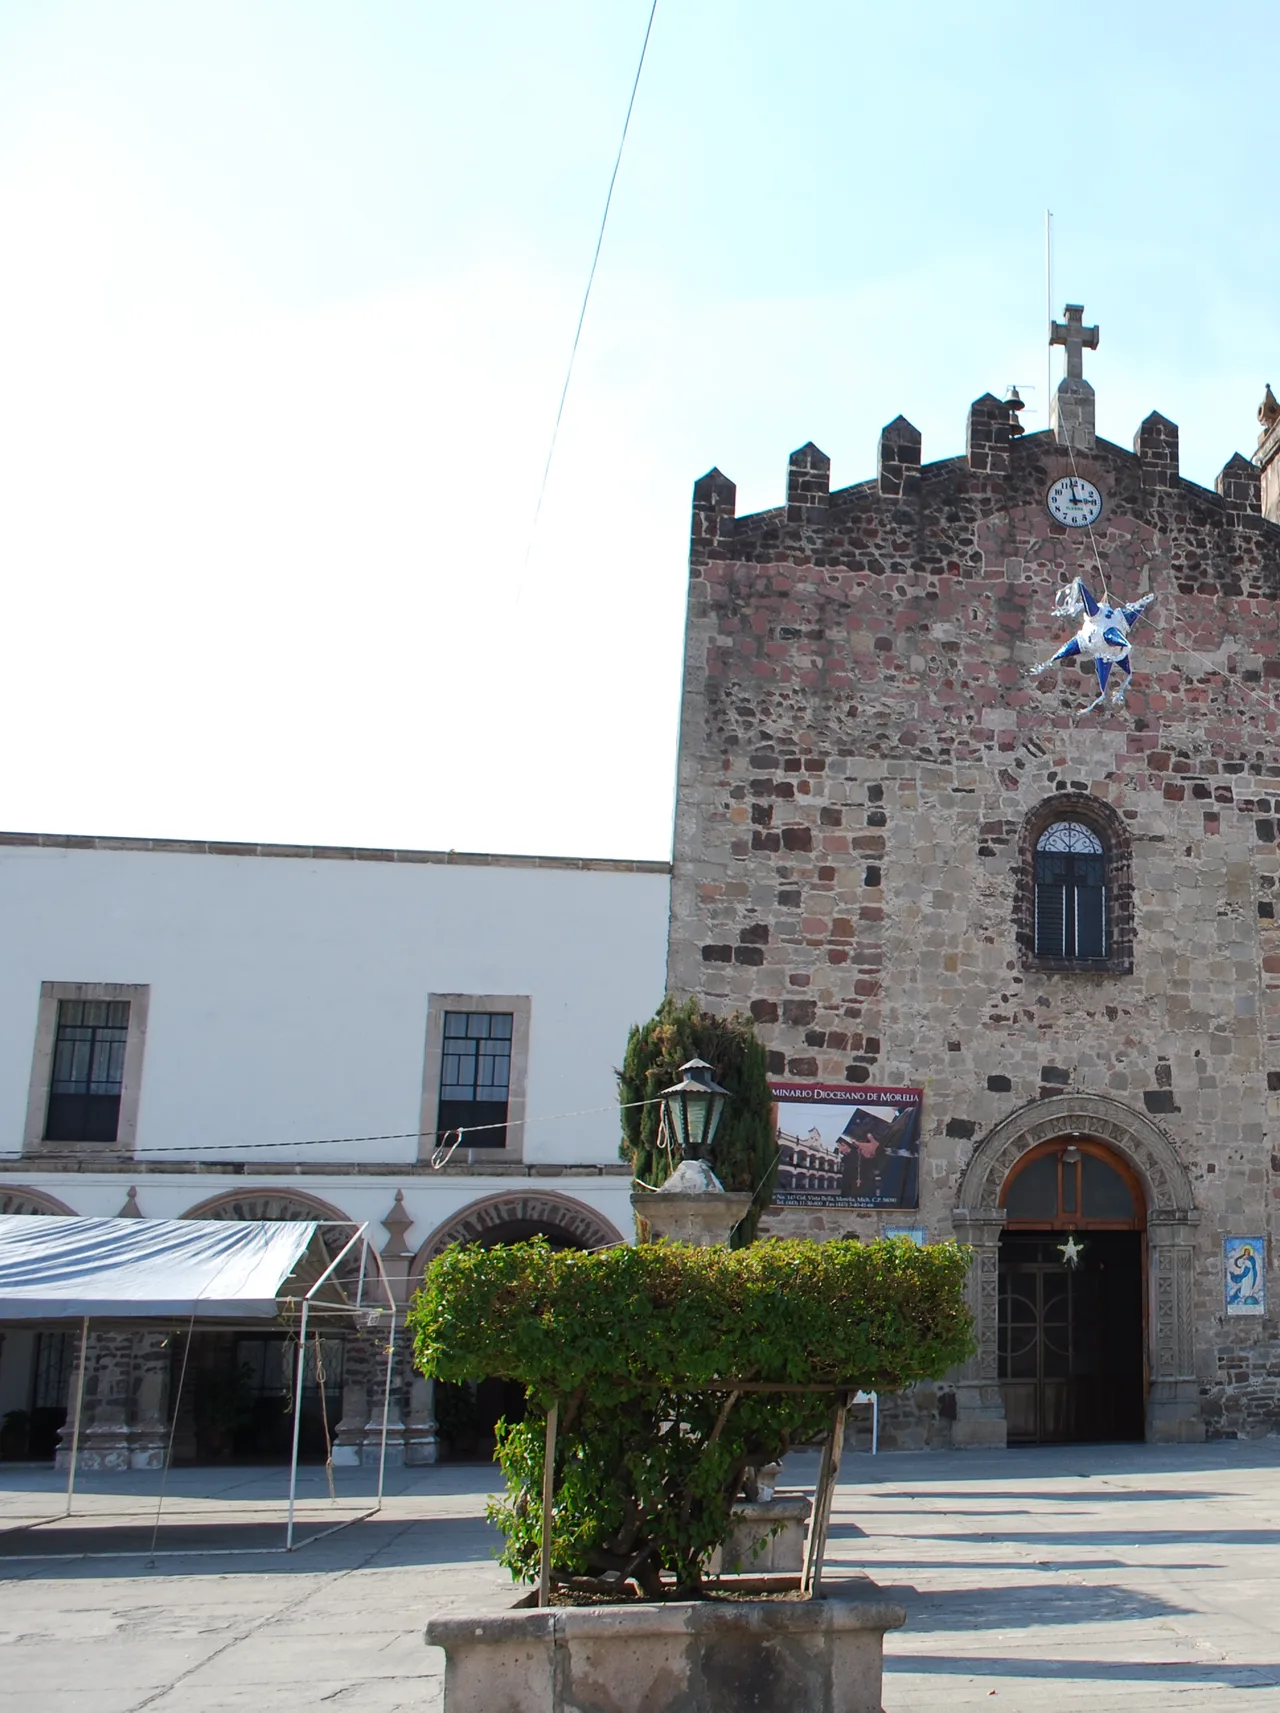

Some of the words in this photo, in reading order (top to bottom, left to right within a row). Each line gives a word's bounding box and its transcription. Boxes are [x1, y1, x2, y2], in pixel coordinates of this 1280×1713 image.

[772, 1088, 812, 1098] MINARIO
[814, 1089, 866, 1100] DIOCESANO
[880, 1093, 919, 1101] MORELIA
